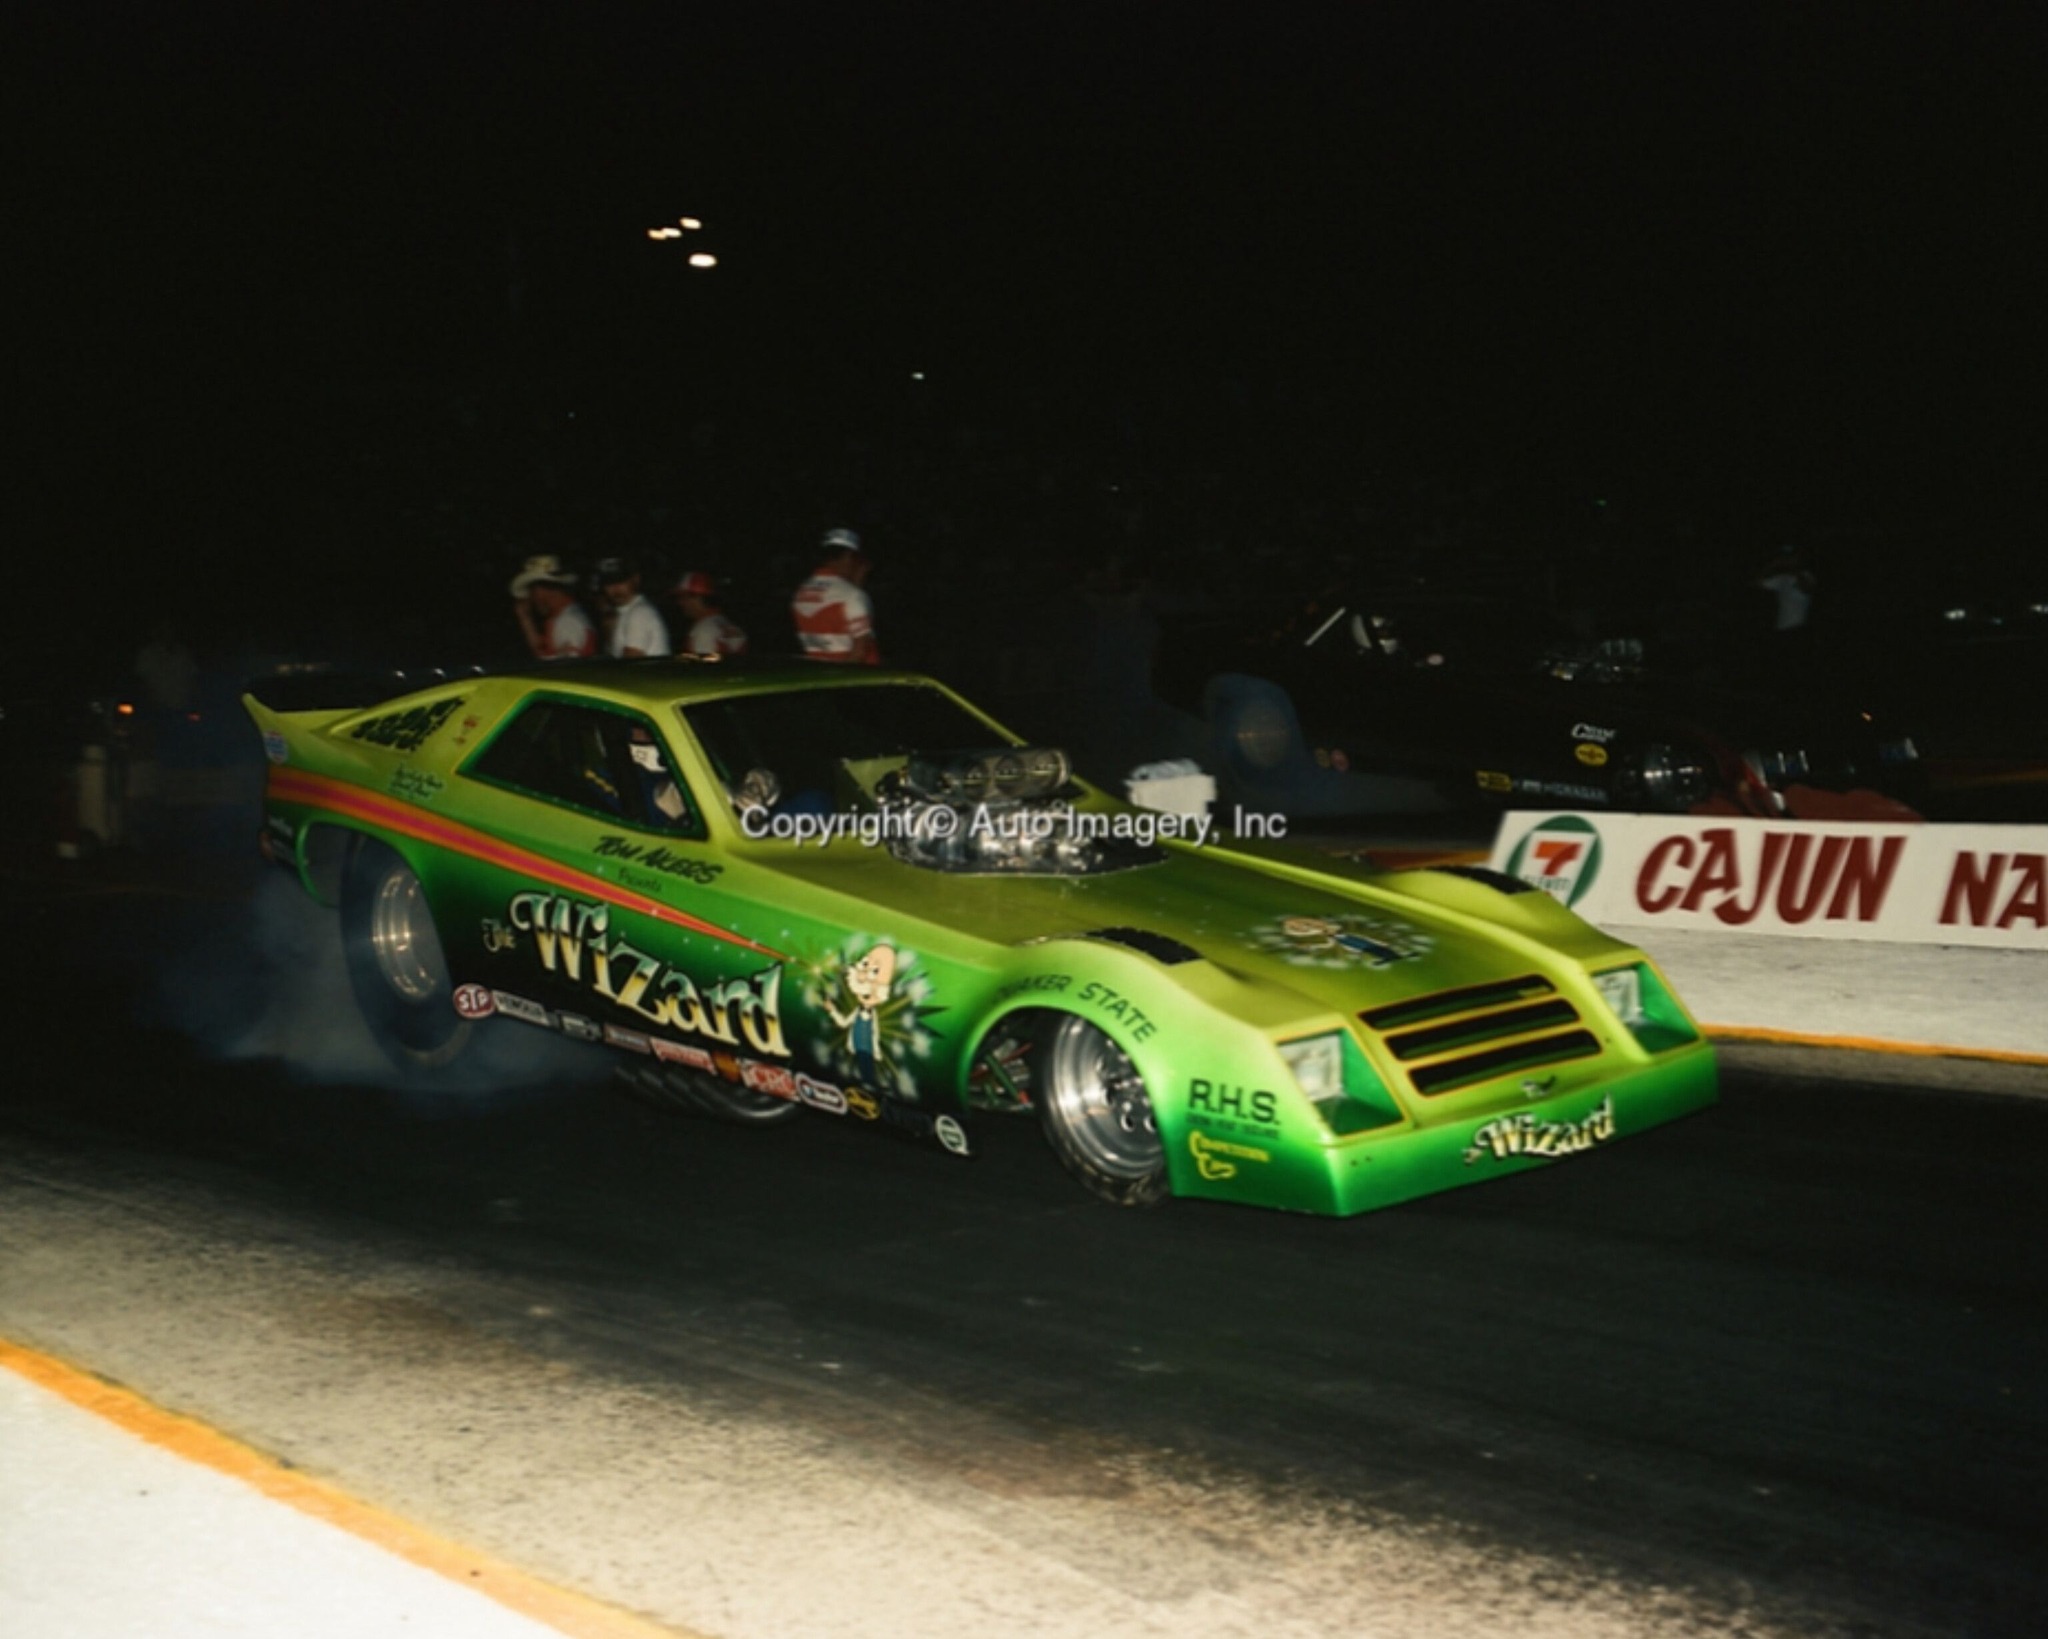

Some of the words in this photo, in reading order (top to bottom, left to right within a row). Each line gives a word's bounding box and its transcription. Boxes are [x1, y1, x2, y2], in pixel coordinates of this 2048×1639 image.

[593, 836, 644, 860] TOM
[634, 846, 725, 884] AKERS
[1533, 840, 1583, 877] 7
[1635, 828, 1907, 925] CAJUN
[1937, 850, 2048, 930] NA
[457, 987, 490, 1012] STP
[510, 892, 793, 1057] Wizard
[1078, 982, 1158, 1043] STATE
[1188, 1078, 1281, 1126] R.H.S.
[1474, 1092, 1615, 1158] Wizard
